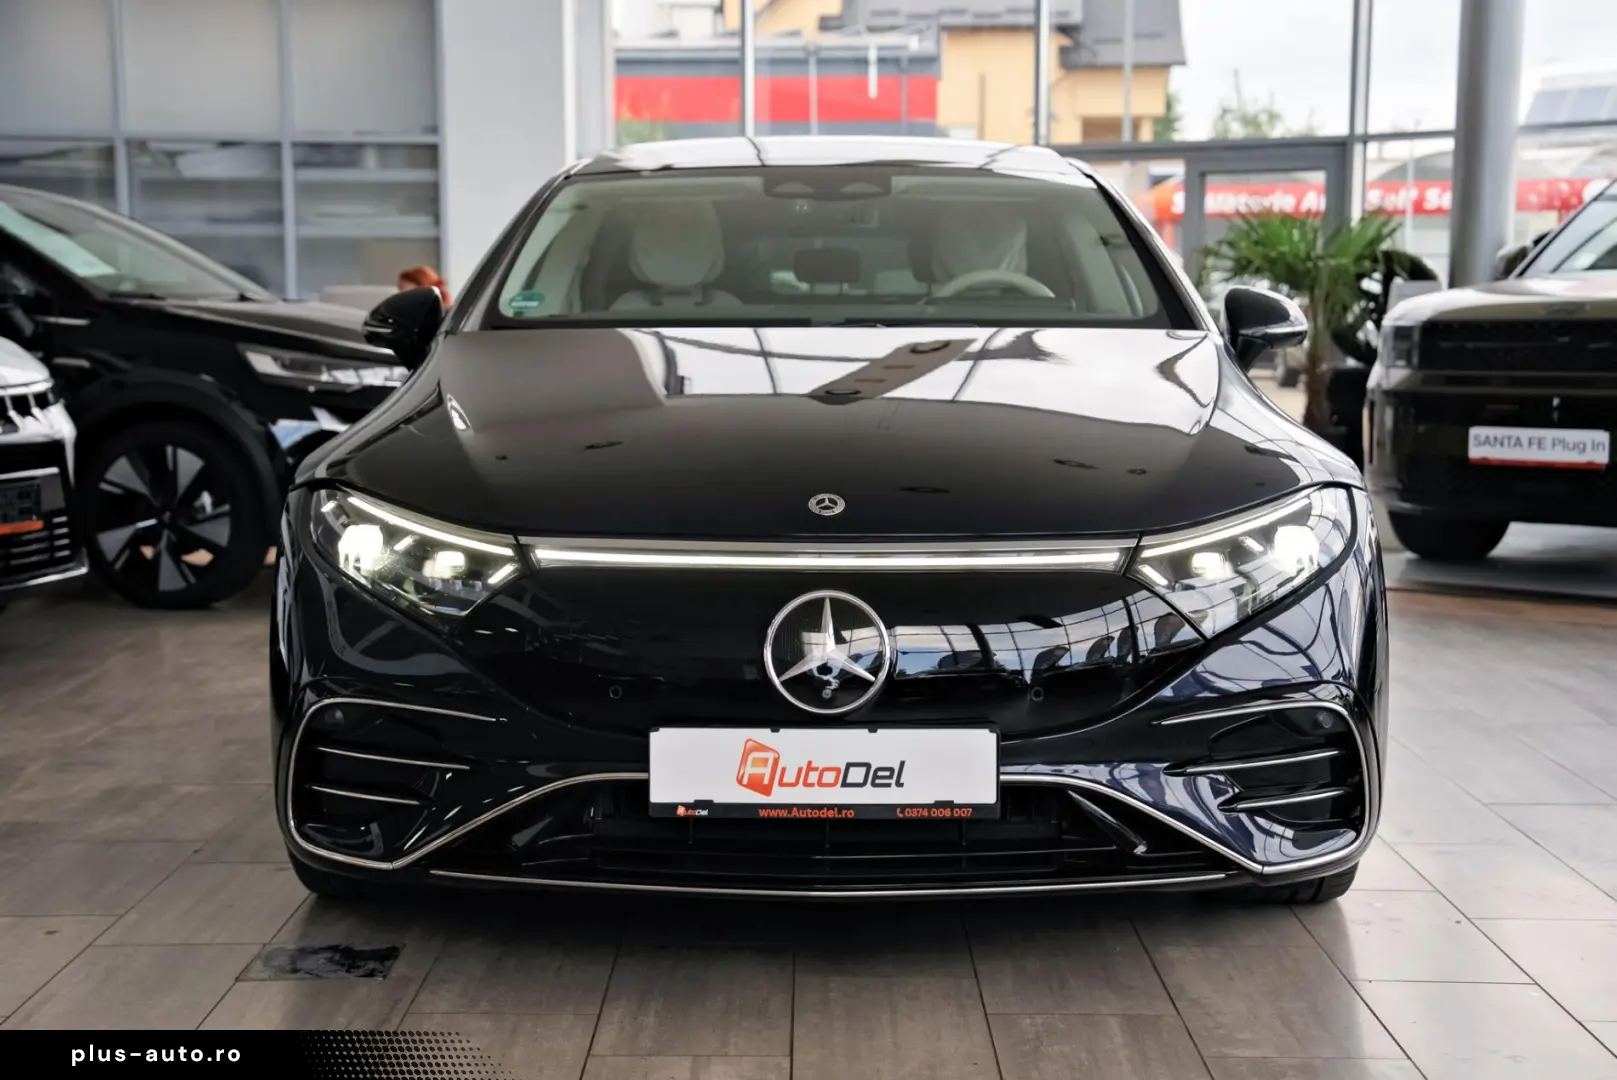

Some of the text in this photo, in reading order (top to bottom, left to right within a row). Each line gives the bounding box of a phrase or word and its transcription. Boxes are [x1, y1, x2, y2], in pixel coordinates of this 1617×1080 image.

[1473, 433, 1606, 455] SANTA FE Plug In
[737, 744, 906, 792] AutoDel
[758, 807, 855, 818] www.Autodel.ro
[905, 808, 973, 817] 0374 006 007
